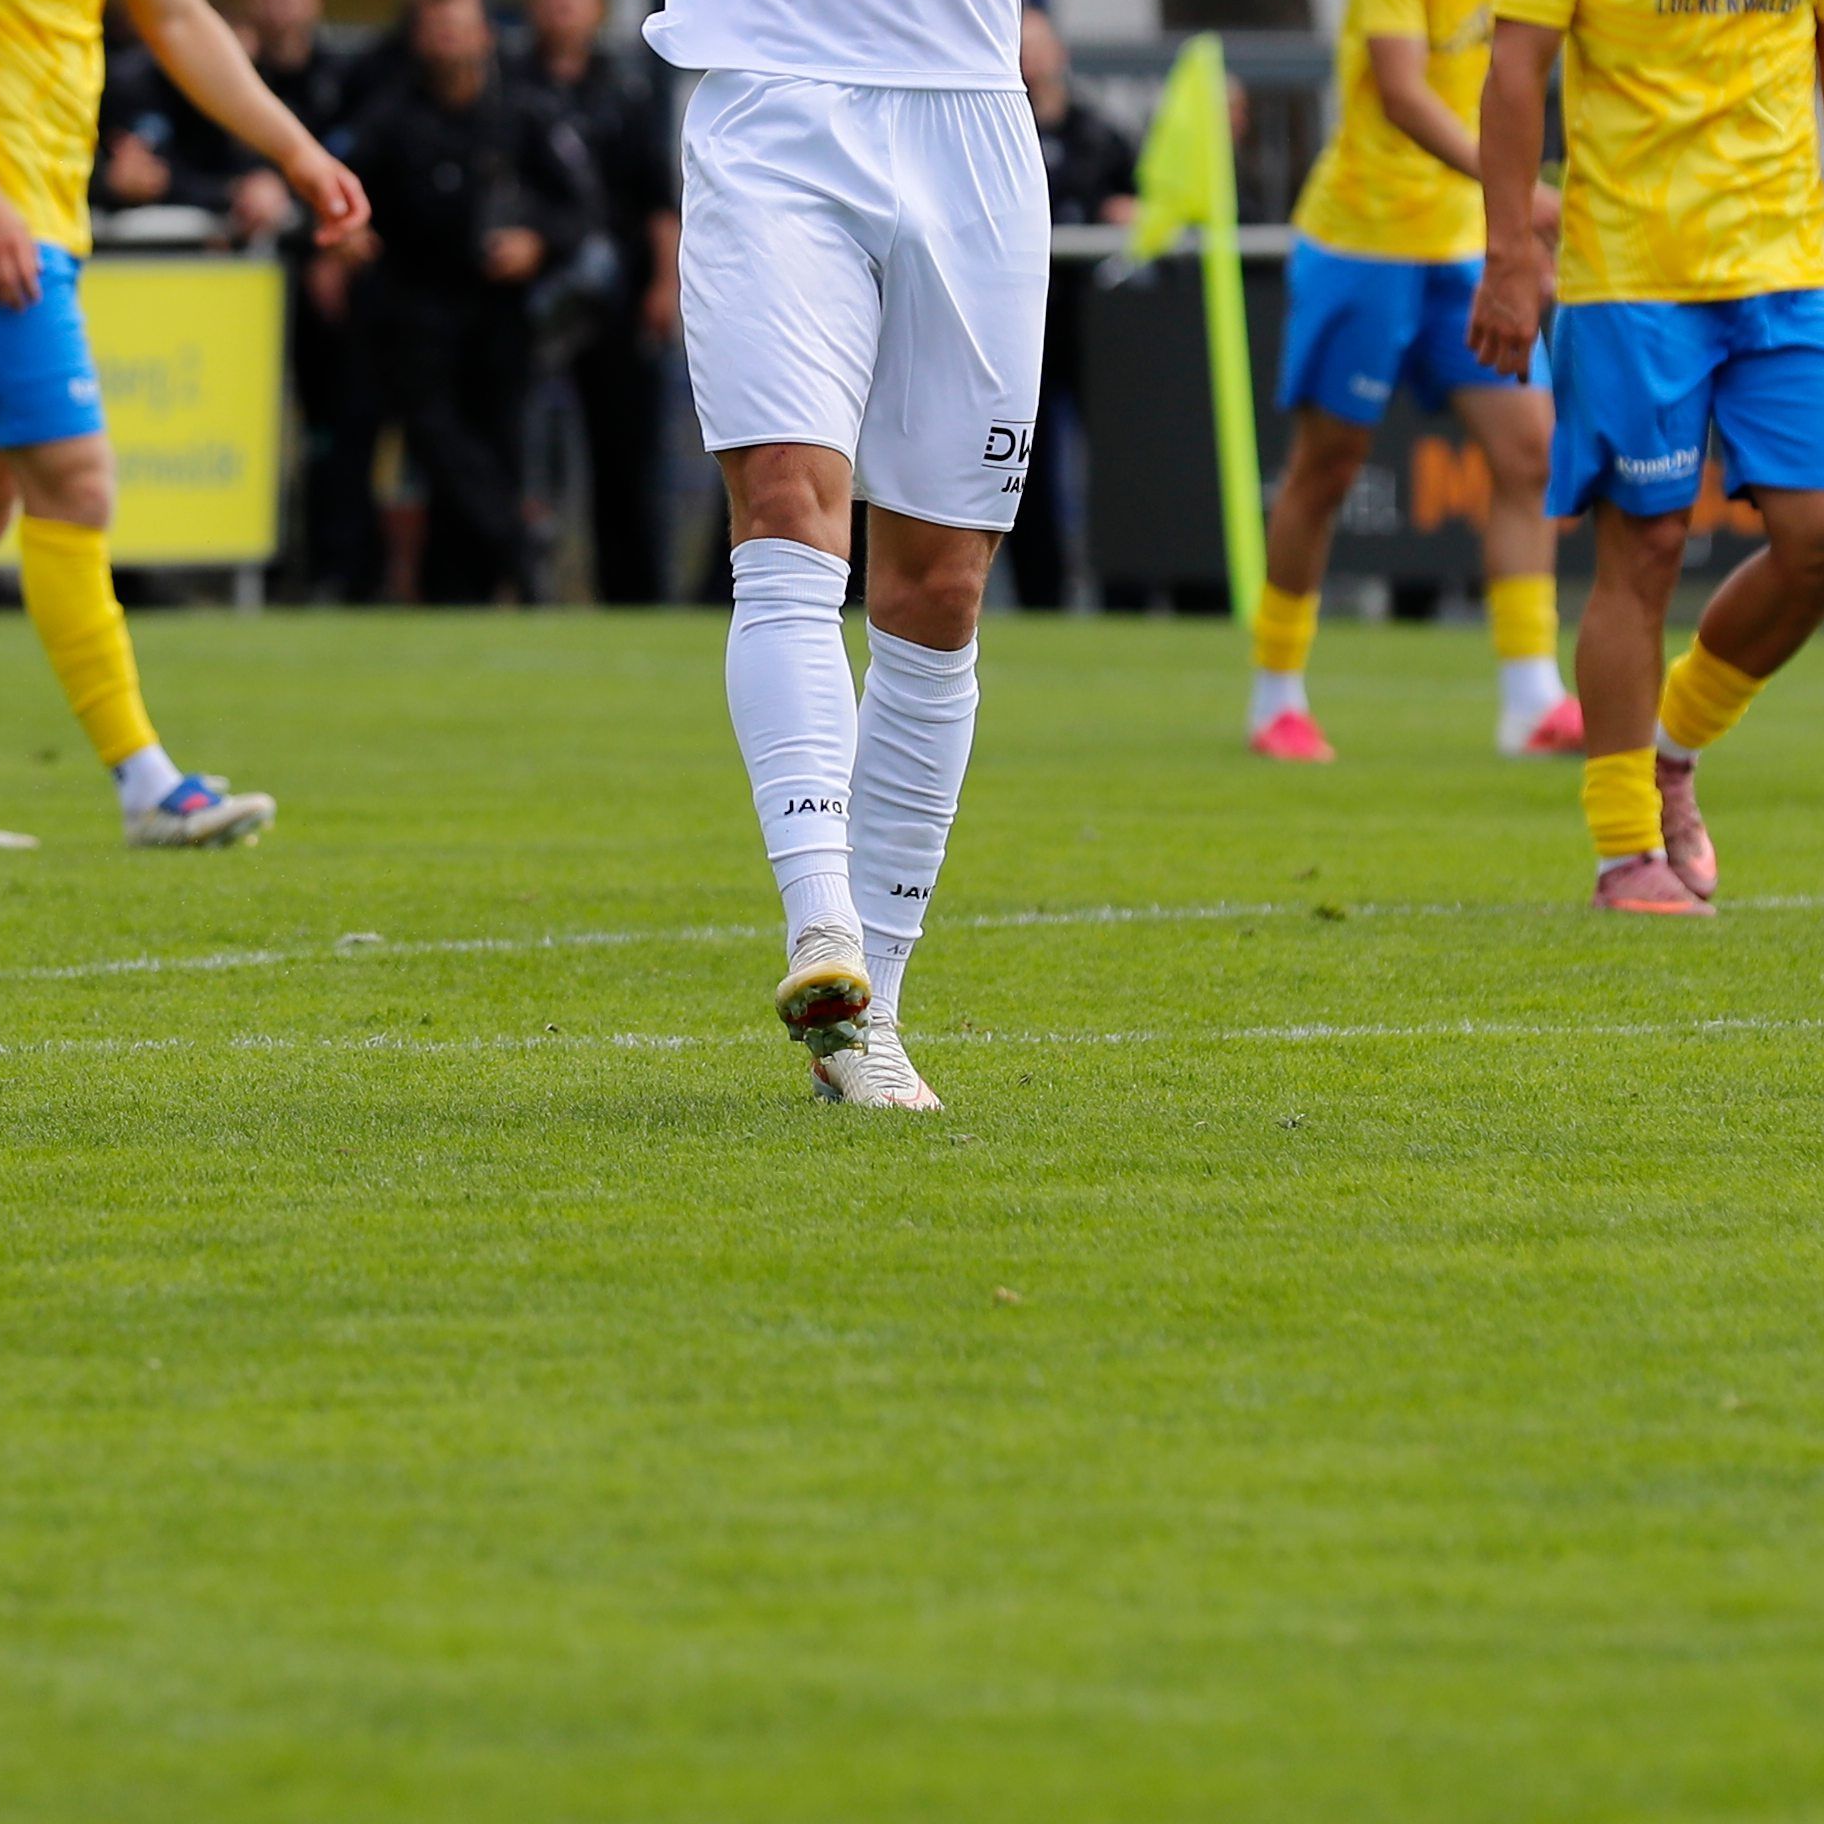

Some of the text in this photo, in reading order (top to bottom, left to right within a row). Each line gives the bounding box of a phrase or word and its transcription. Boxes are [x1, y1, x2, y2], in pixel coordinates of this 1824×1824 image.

[1000, 475, 1026, 494] JA
[784, 798, 844, 816] JAKO
[889, 883, 936, 901] JAK
